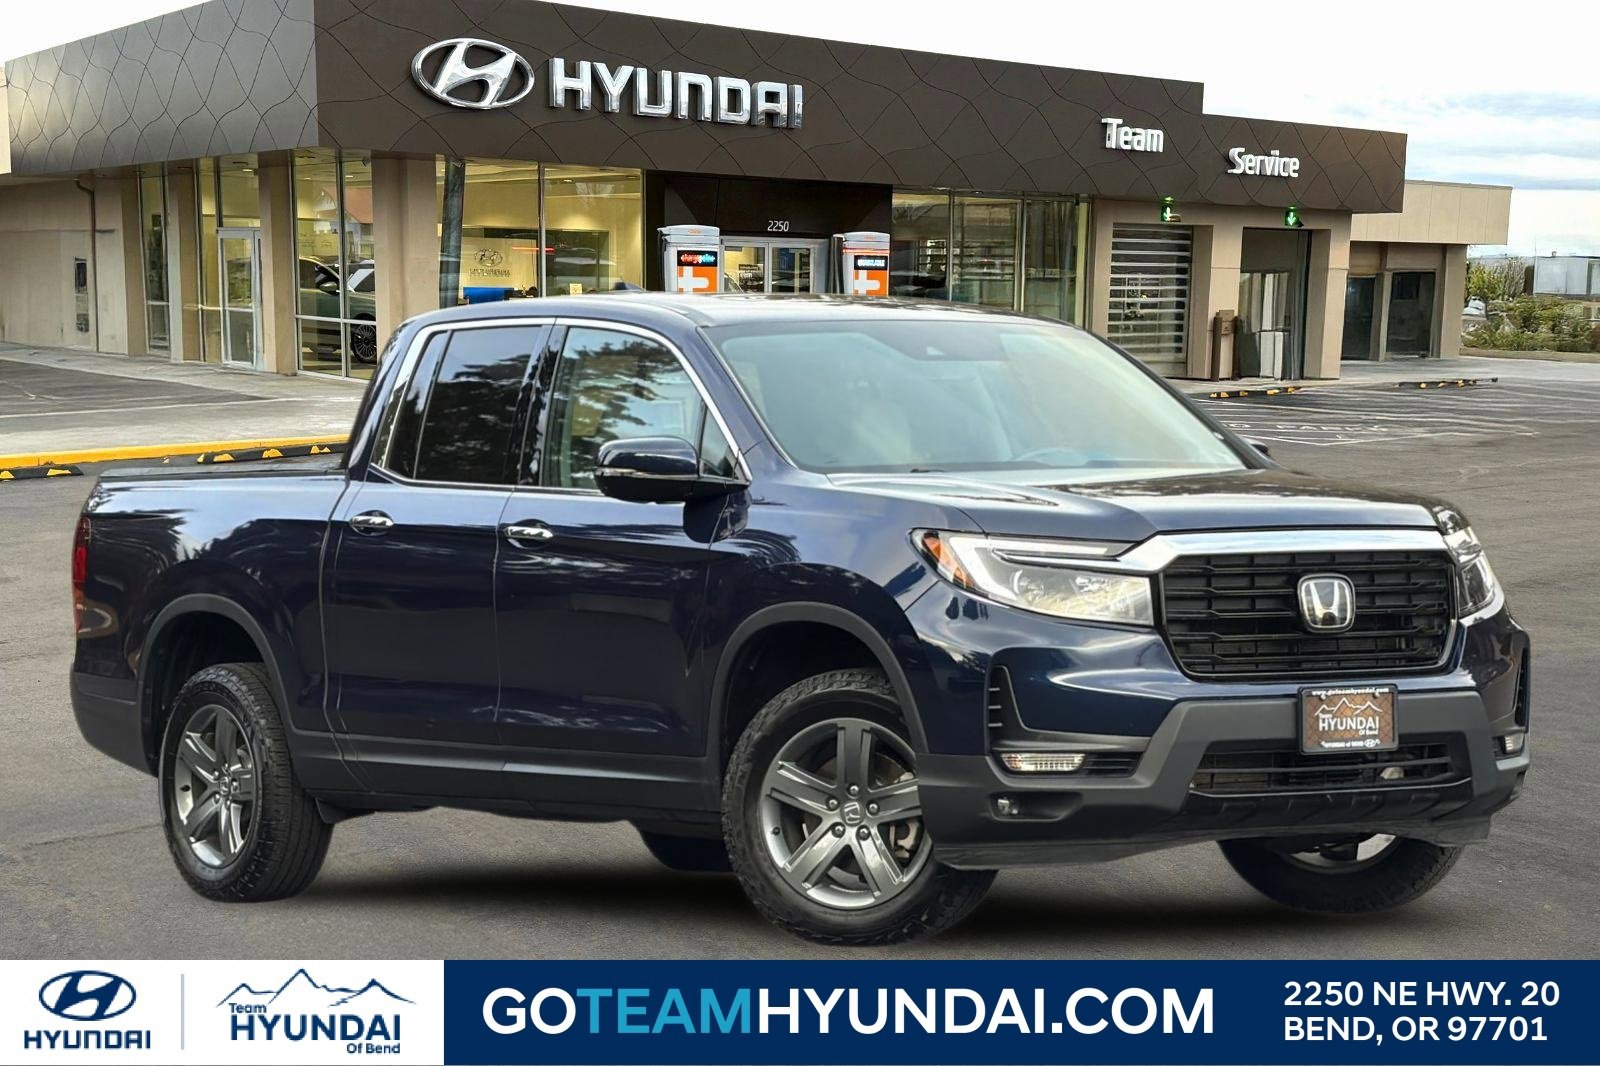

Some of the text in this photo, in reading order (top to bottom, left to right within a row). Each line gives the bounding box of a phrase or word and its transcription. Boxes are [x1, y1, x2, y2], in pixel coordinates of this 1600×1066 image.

[548, 57, 804, 129] HYUNDAI
[1101, 117, 1164, 153] Team
[1227, 147, 1300, 178] Service
[767, 220, 789, 232] 2250
[1318, 716, 1380, 732] HYUNDAI
